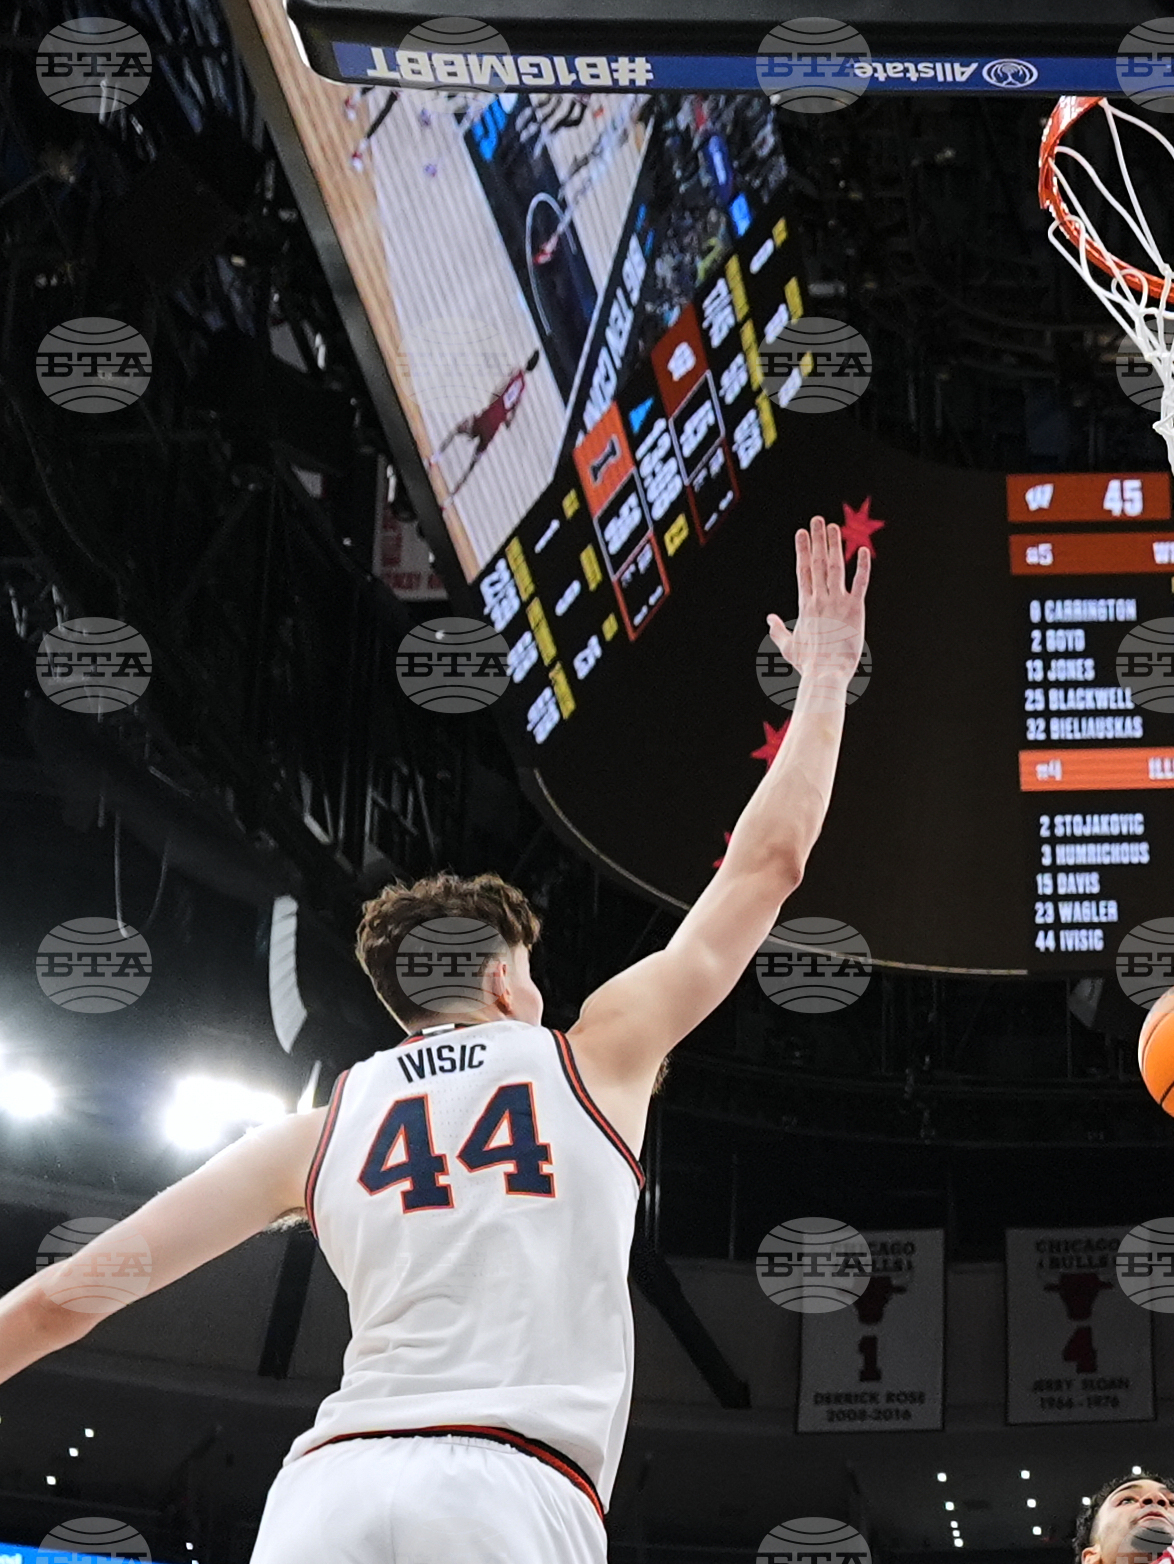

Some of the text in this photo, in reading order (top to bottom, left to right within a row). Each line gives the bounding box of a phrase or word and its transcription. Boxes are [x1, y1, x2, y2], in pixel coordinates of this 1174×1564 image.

[367, 47, 653, 87] #B1GMBBT
[855, 60, 979, 82] Allstate
[1103, 479, 1143, 517] 45
[1031, 629, 1042, 652] 2
[1048, 686, 1135, 710] BLACKWELL
[1026, 717, 1047, 740] 32
[1039, 815, 1050, 837] 2
[1058, 900, 1118, 924] WAGLER
[1035, 930, 1056, 952] 44
[397, 1043, 487, 1084] IVISIC
[357, 1081, 546, 1214] 44
[858, 1335, 882, 1382] 1
[1062, 1325, 1099, 1374] 4
